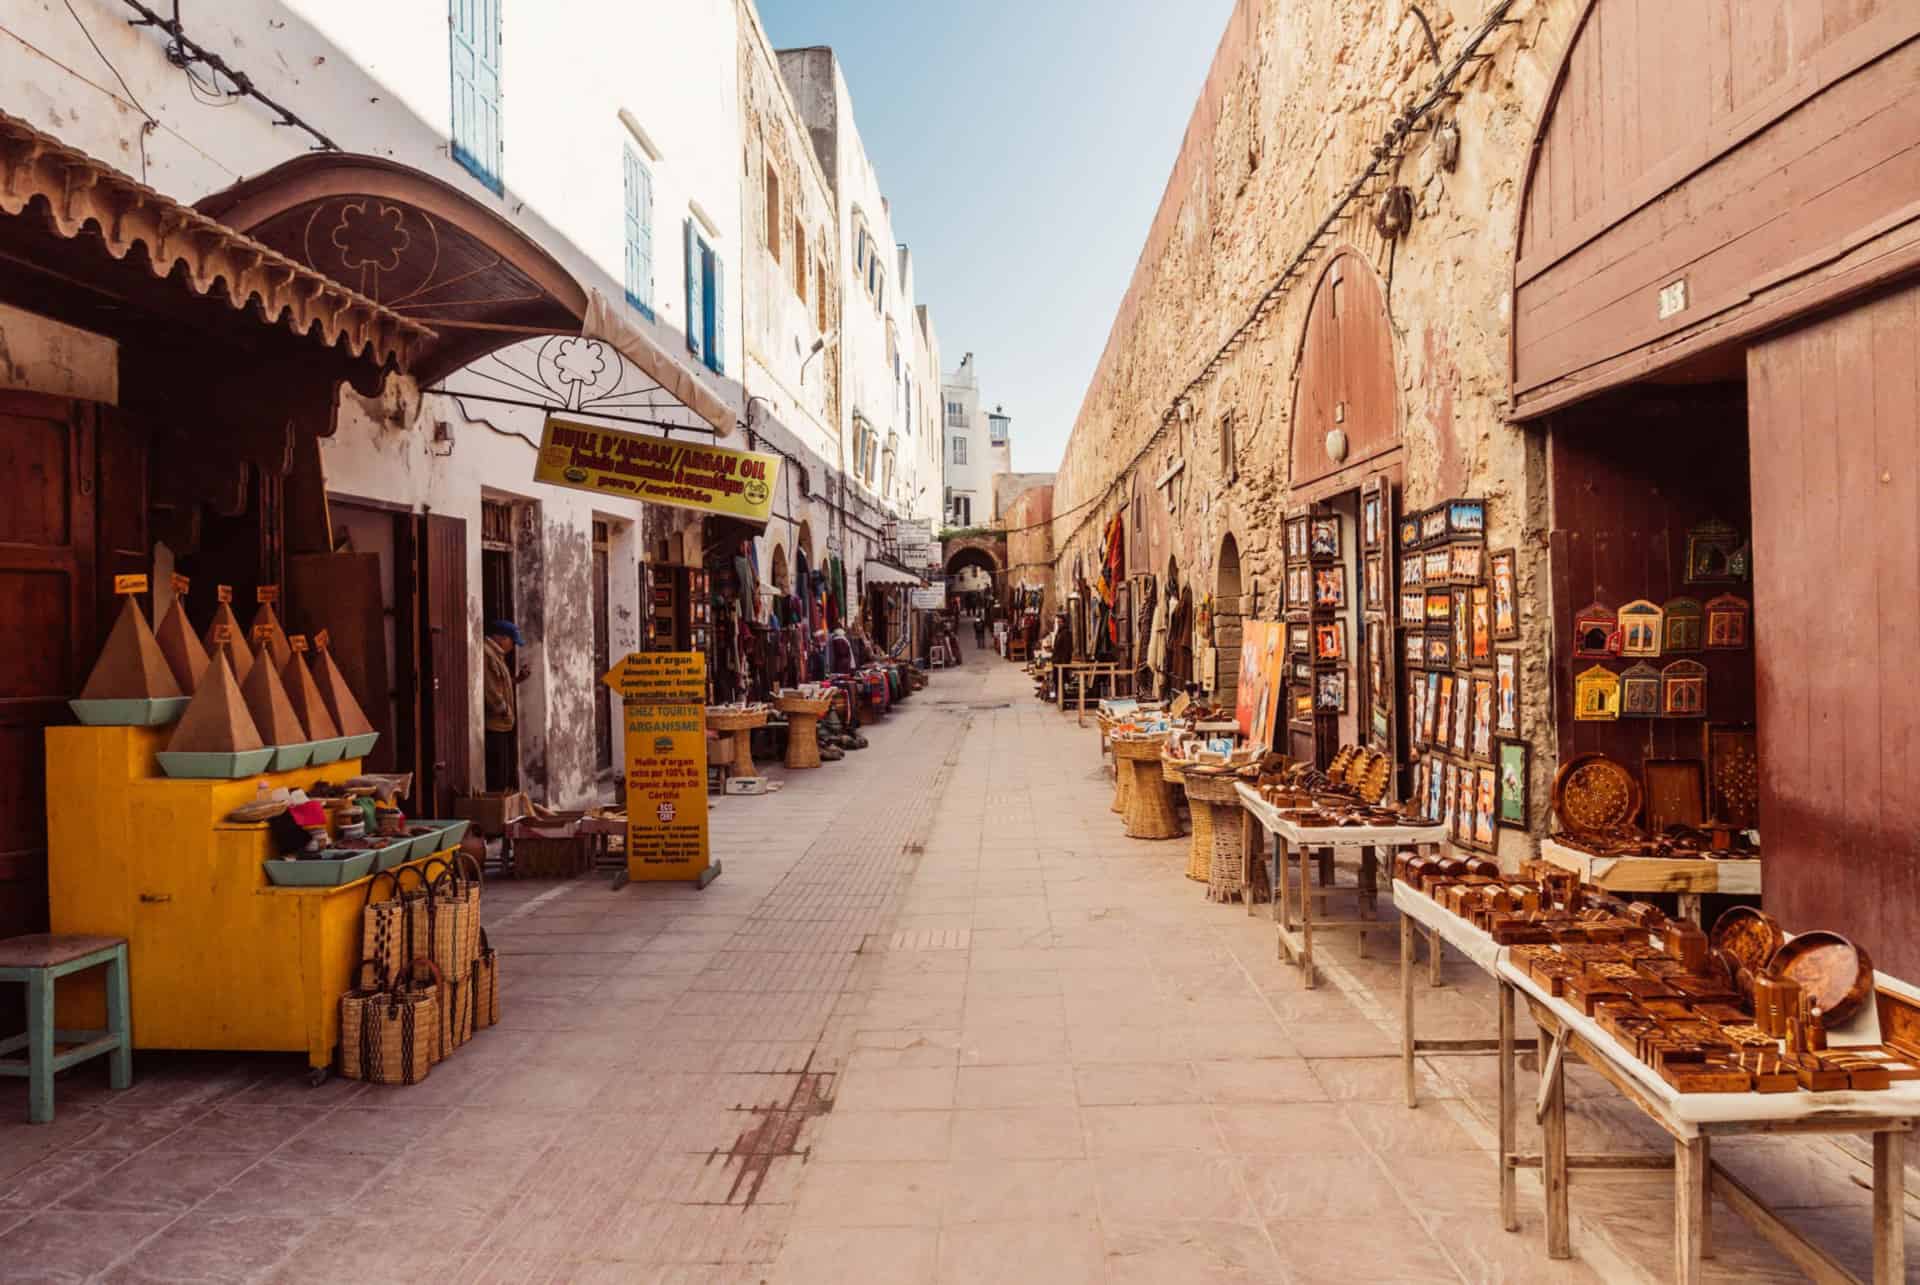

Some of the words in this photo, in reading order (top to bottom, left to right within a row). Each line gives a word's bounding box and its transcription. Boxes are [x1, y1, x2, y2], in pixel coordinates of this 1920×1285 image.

[552, 427, 598, 451] HUILE
[740, 458, 766, 481] OIL
[628, 655, 652, 665] Huile
[655, 655, 692, 667] d'argan
[629, 705, 654, 717] CHEZ
[634, 758, 657, 767] Huile
